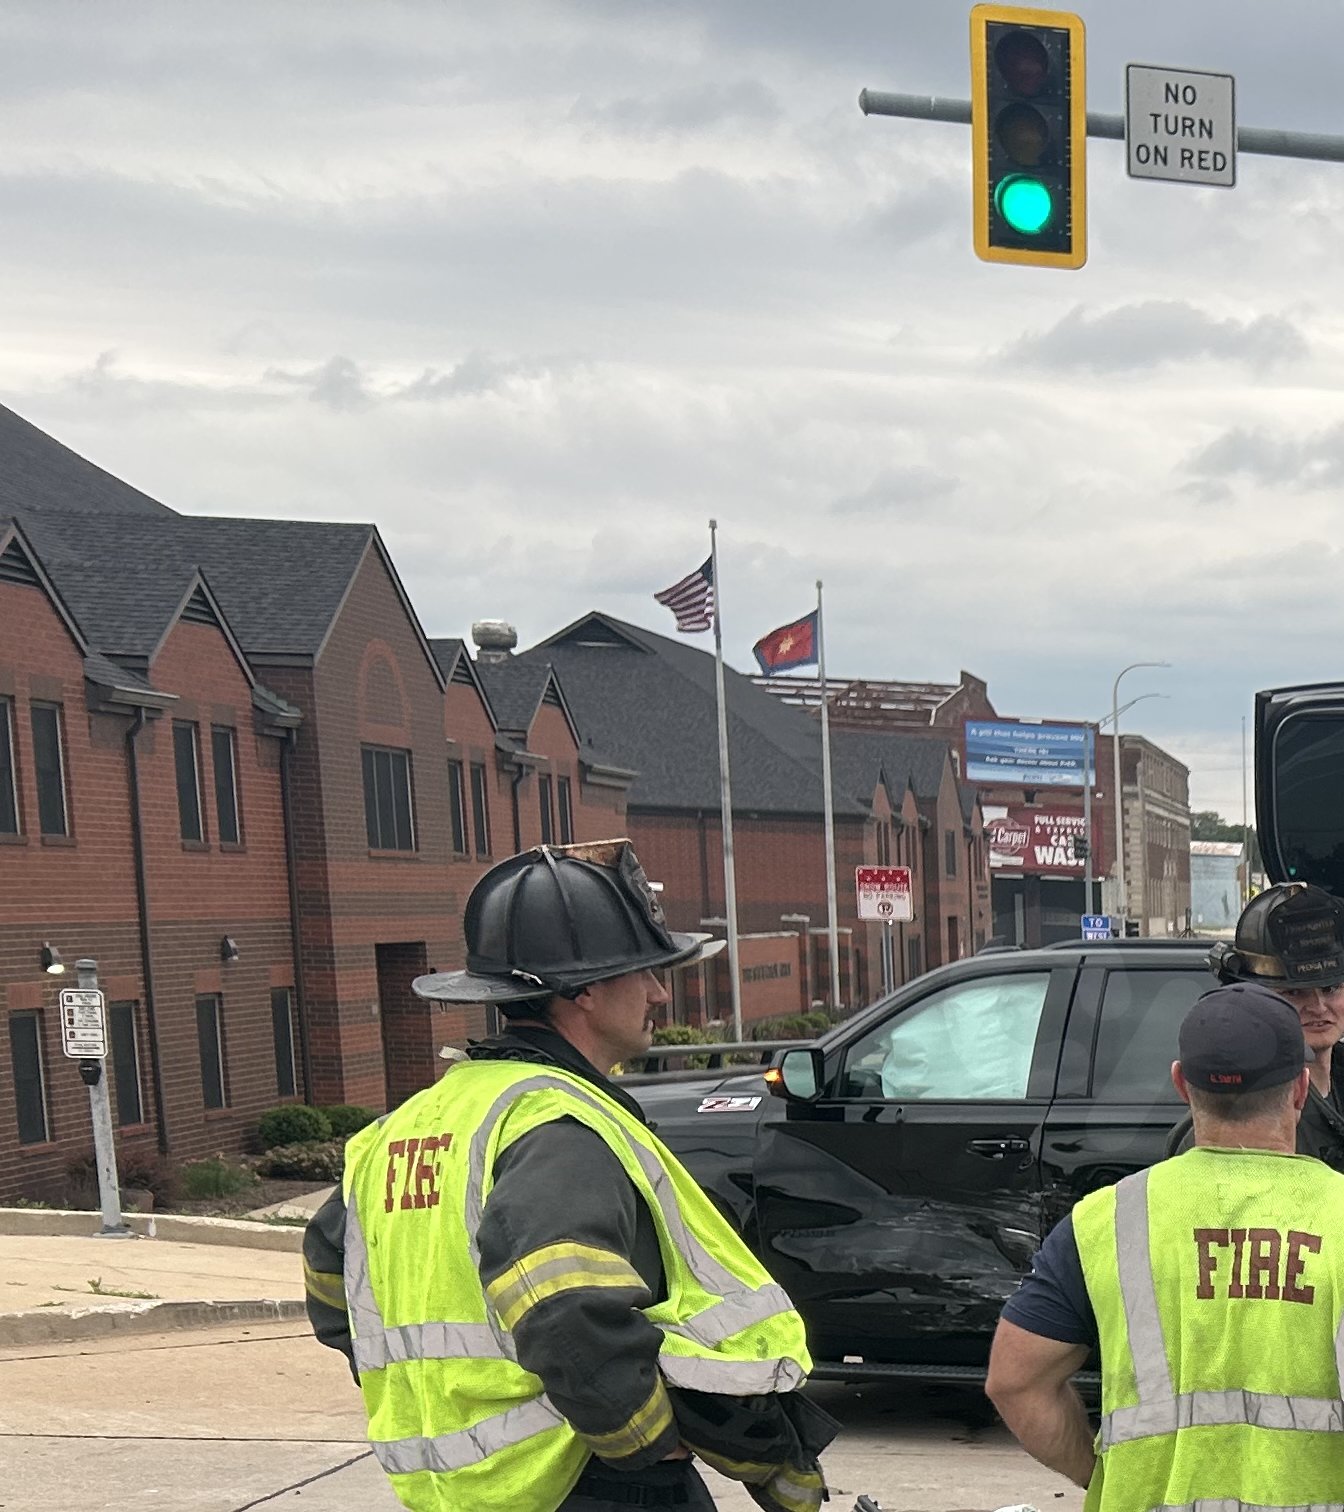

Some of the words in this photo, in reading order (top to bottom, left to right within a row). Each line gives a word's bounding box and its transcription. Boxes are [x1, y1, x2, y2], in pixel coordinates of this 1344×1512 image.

[1165, 82, 1197, 106] NO
[1149, 113, 1214, 140] TURN
[1136, 144, 1168, 167] ON
[1180, 148, 1227, 172] RED
[1034, 814, 1055, 826] FULL
[1056, 816, 1086, 827] SERVIC
[1046, 826, 1085, 836] EXPRES
[997, 827, 1027, 847] Carpet
[1089, 917, 1103, 928] TO
[1193, 1228, 1323, 1305] FIRE
